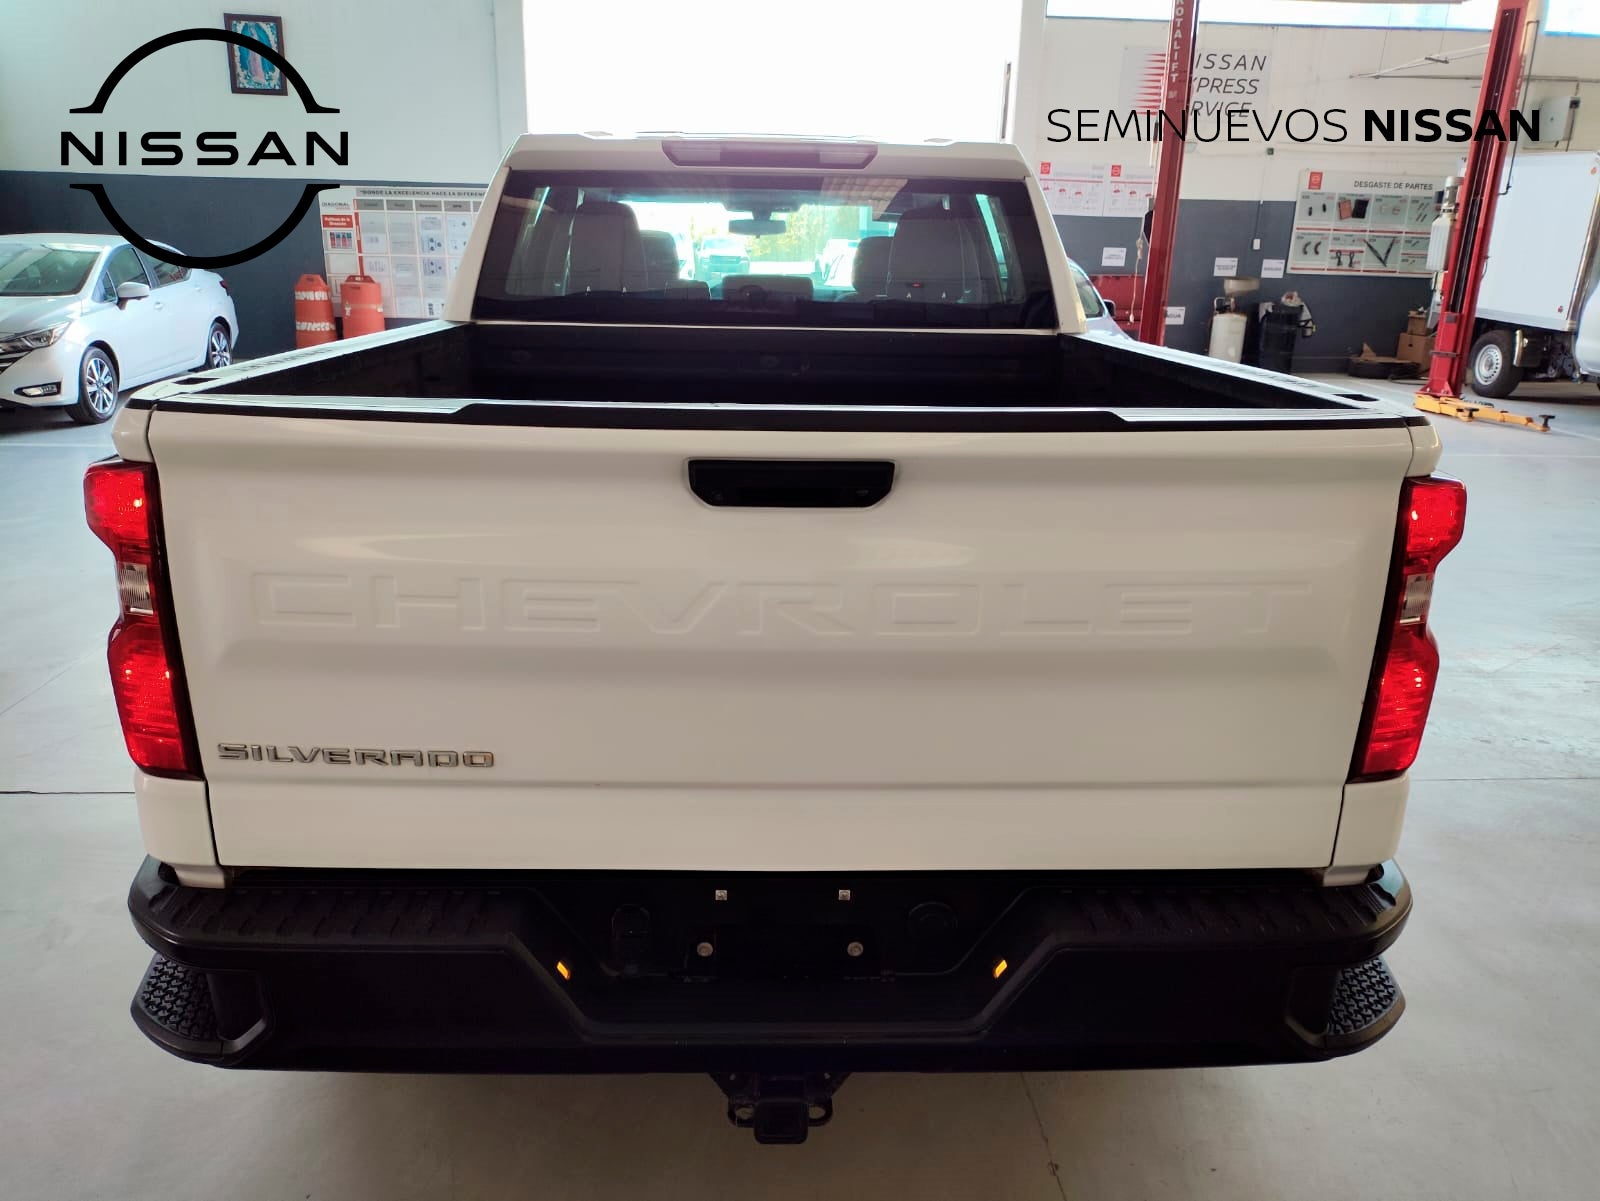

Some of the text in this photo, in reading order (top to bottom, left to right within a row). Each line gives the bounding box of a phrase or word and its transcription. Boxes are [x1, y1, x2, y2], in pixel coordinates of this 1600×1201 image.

[1194, 53, 1267, 71] ISSAN
[1193, 77, 1260, 95] PRESS
[1190, 101, 1253, 118] RVICE
[1353, 180, 1392, 189] DESGASTE
[1405, 182, 1433, 191] PARTES
[251, 570, 1313, 638] CHEVROLET
[217, 743, 494, 768] SILVERADO
